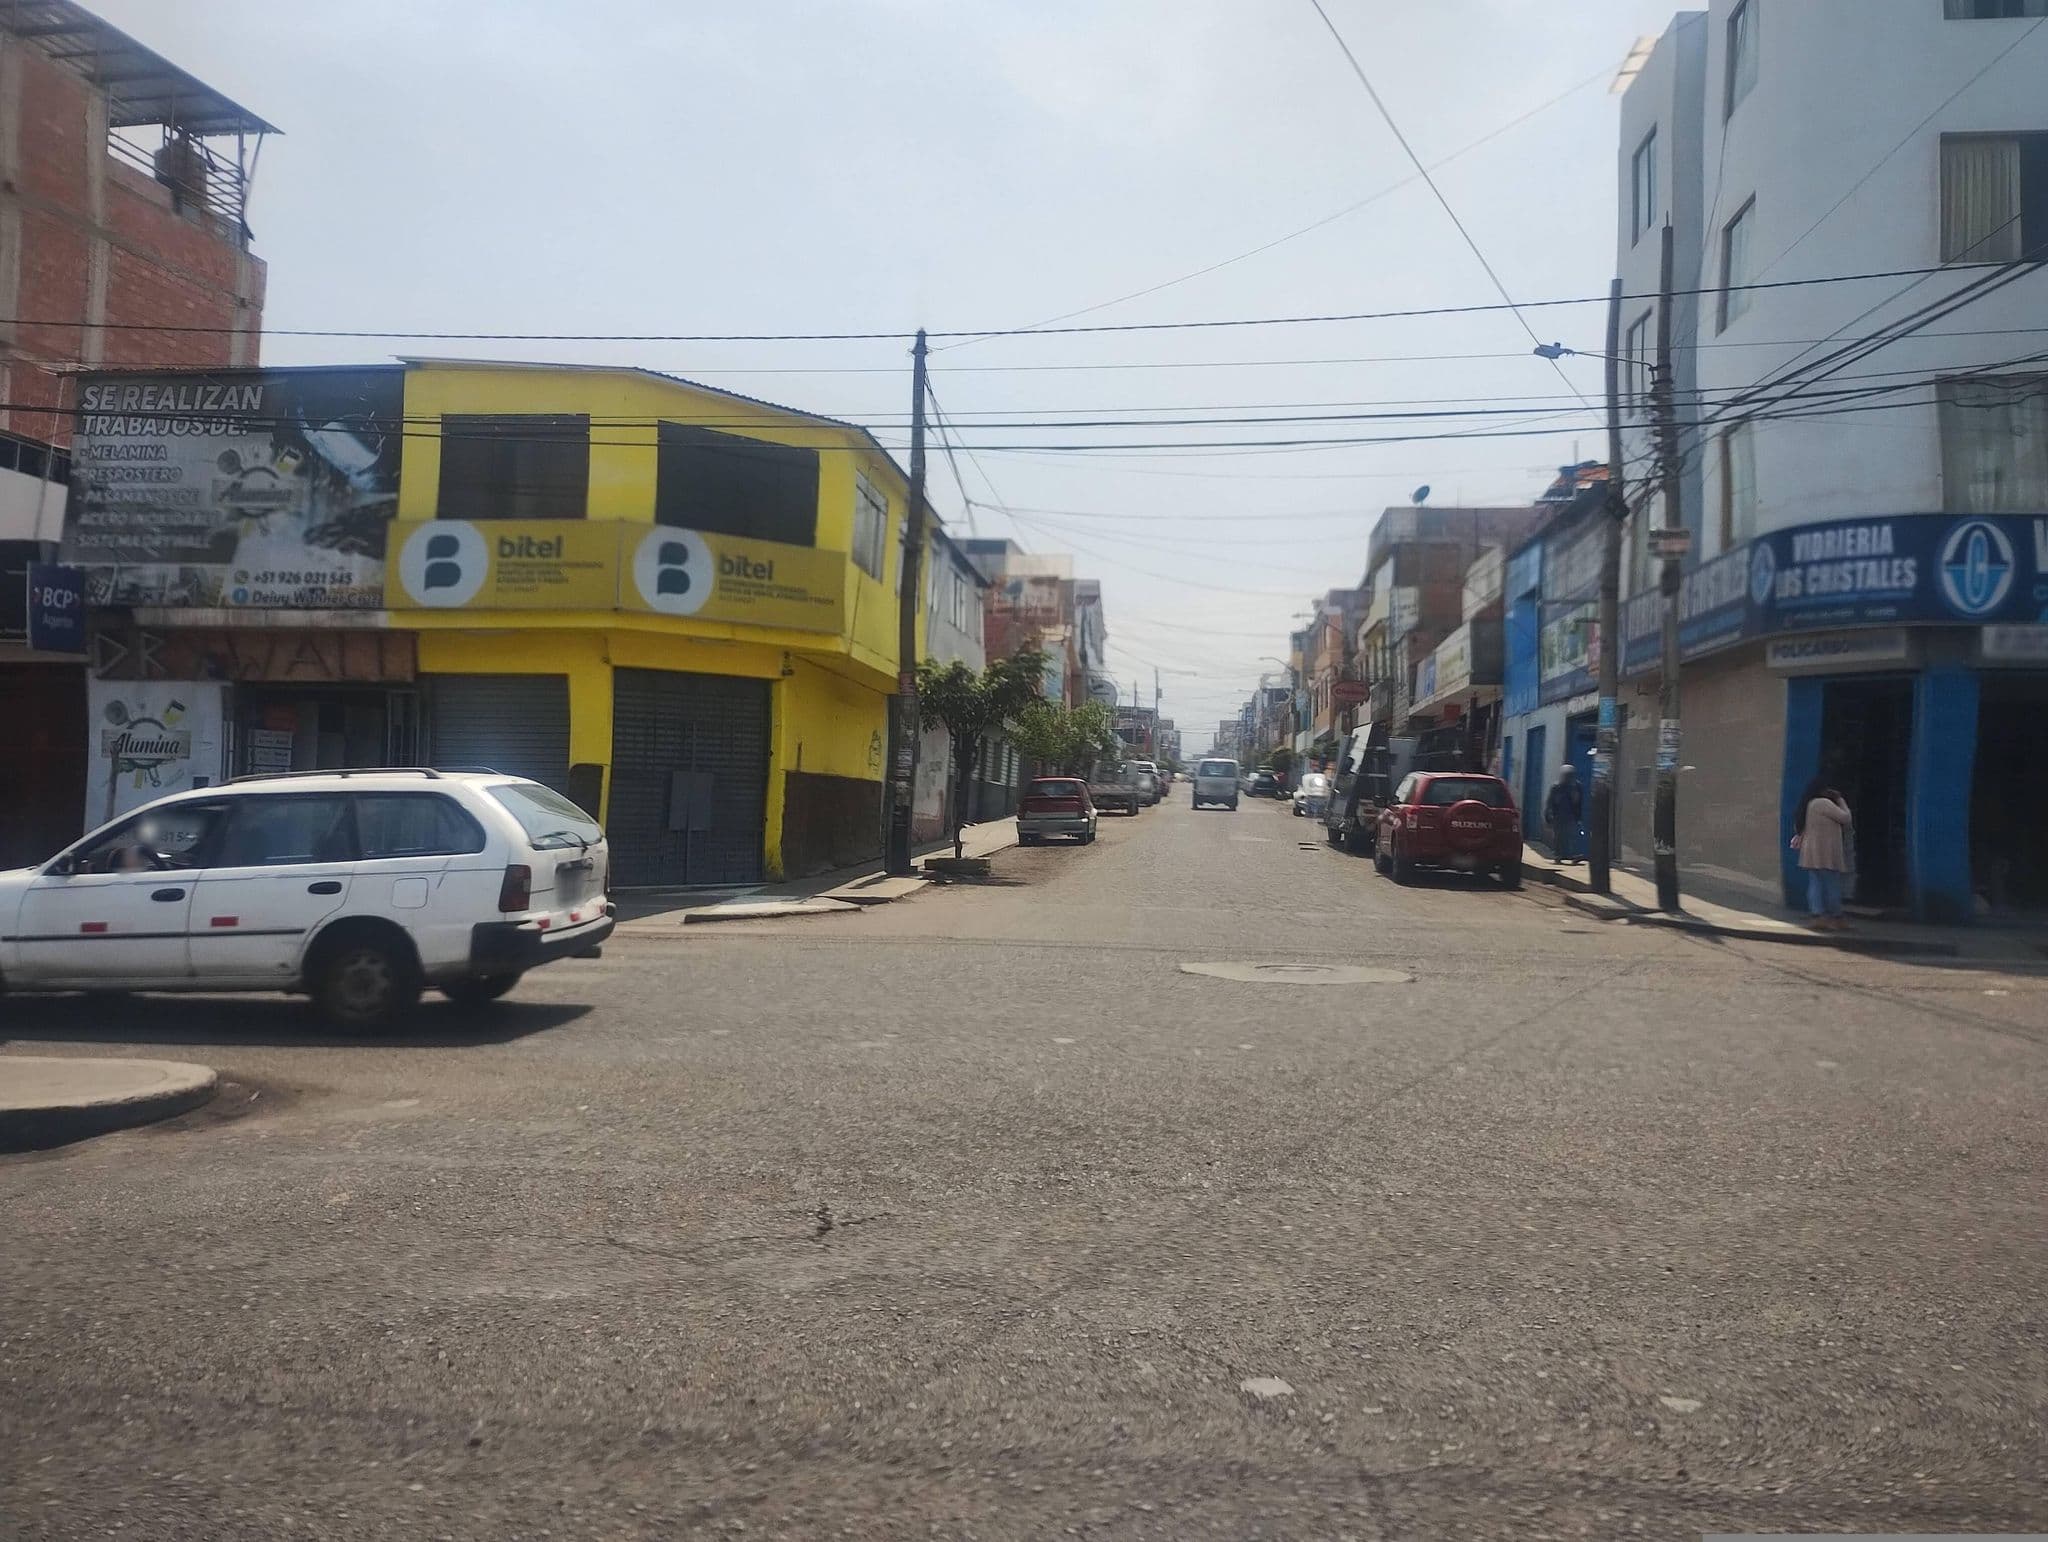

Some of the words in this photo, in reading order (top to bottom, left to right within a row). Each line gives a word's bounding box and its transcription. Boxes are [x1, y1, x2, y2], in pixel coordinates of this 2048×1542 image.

[82, 385, 117, 411] SE
[122, 385, 264, 411] REALIZAN
[82, 414, 206, 436] TRABAJOS
[88, 444, 168, 461] MELAMINA
[497, 534, 564, 559] bitel
[1791, 525, 1895, 562] VIDRIERIA
[718, 553, 775, 581] bitel
[1805, 557, 1918, 595] CRISTALES
[42, 586, 73, 609] BCP
[109, 732, 181, 755] Alumina
[1451, 820, 1492, 829] SUZUKI
